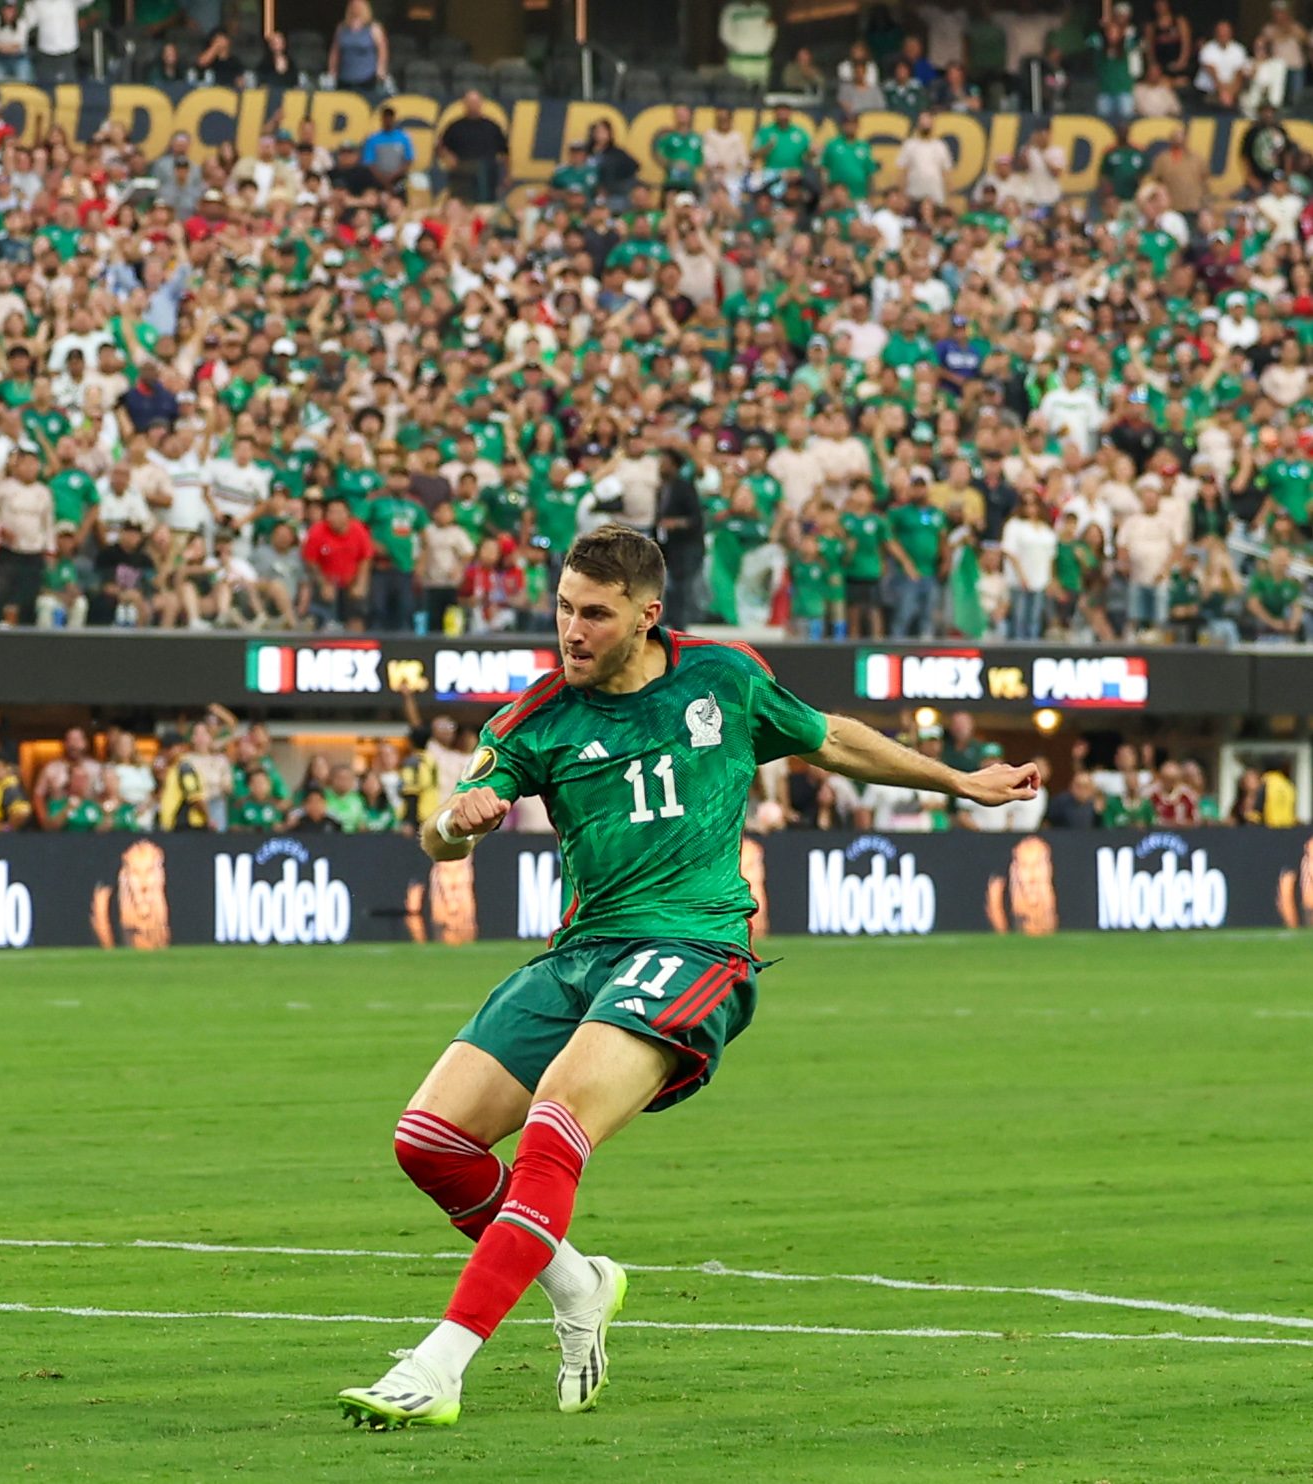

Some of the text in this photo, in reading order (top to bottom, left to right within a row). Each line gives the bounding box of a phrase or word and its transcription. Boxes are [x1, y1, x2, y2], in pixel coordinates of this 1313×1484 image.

[296, 648, 382, 692] MEX
[434, 650, 510, 693] PAN
[901, 656, 984, 699] MEX
[1032, 658, 1104, 699] PAN
[623, 754, 685, 824] 11
[214, 853, 351, 945] Modelo
[808, 849, 935, 936] Modelo
[1097, 847, 1227, 930] Modelo
[613, 949, 684, 999] 11
